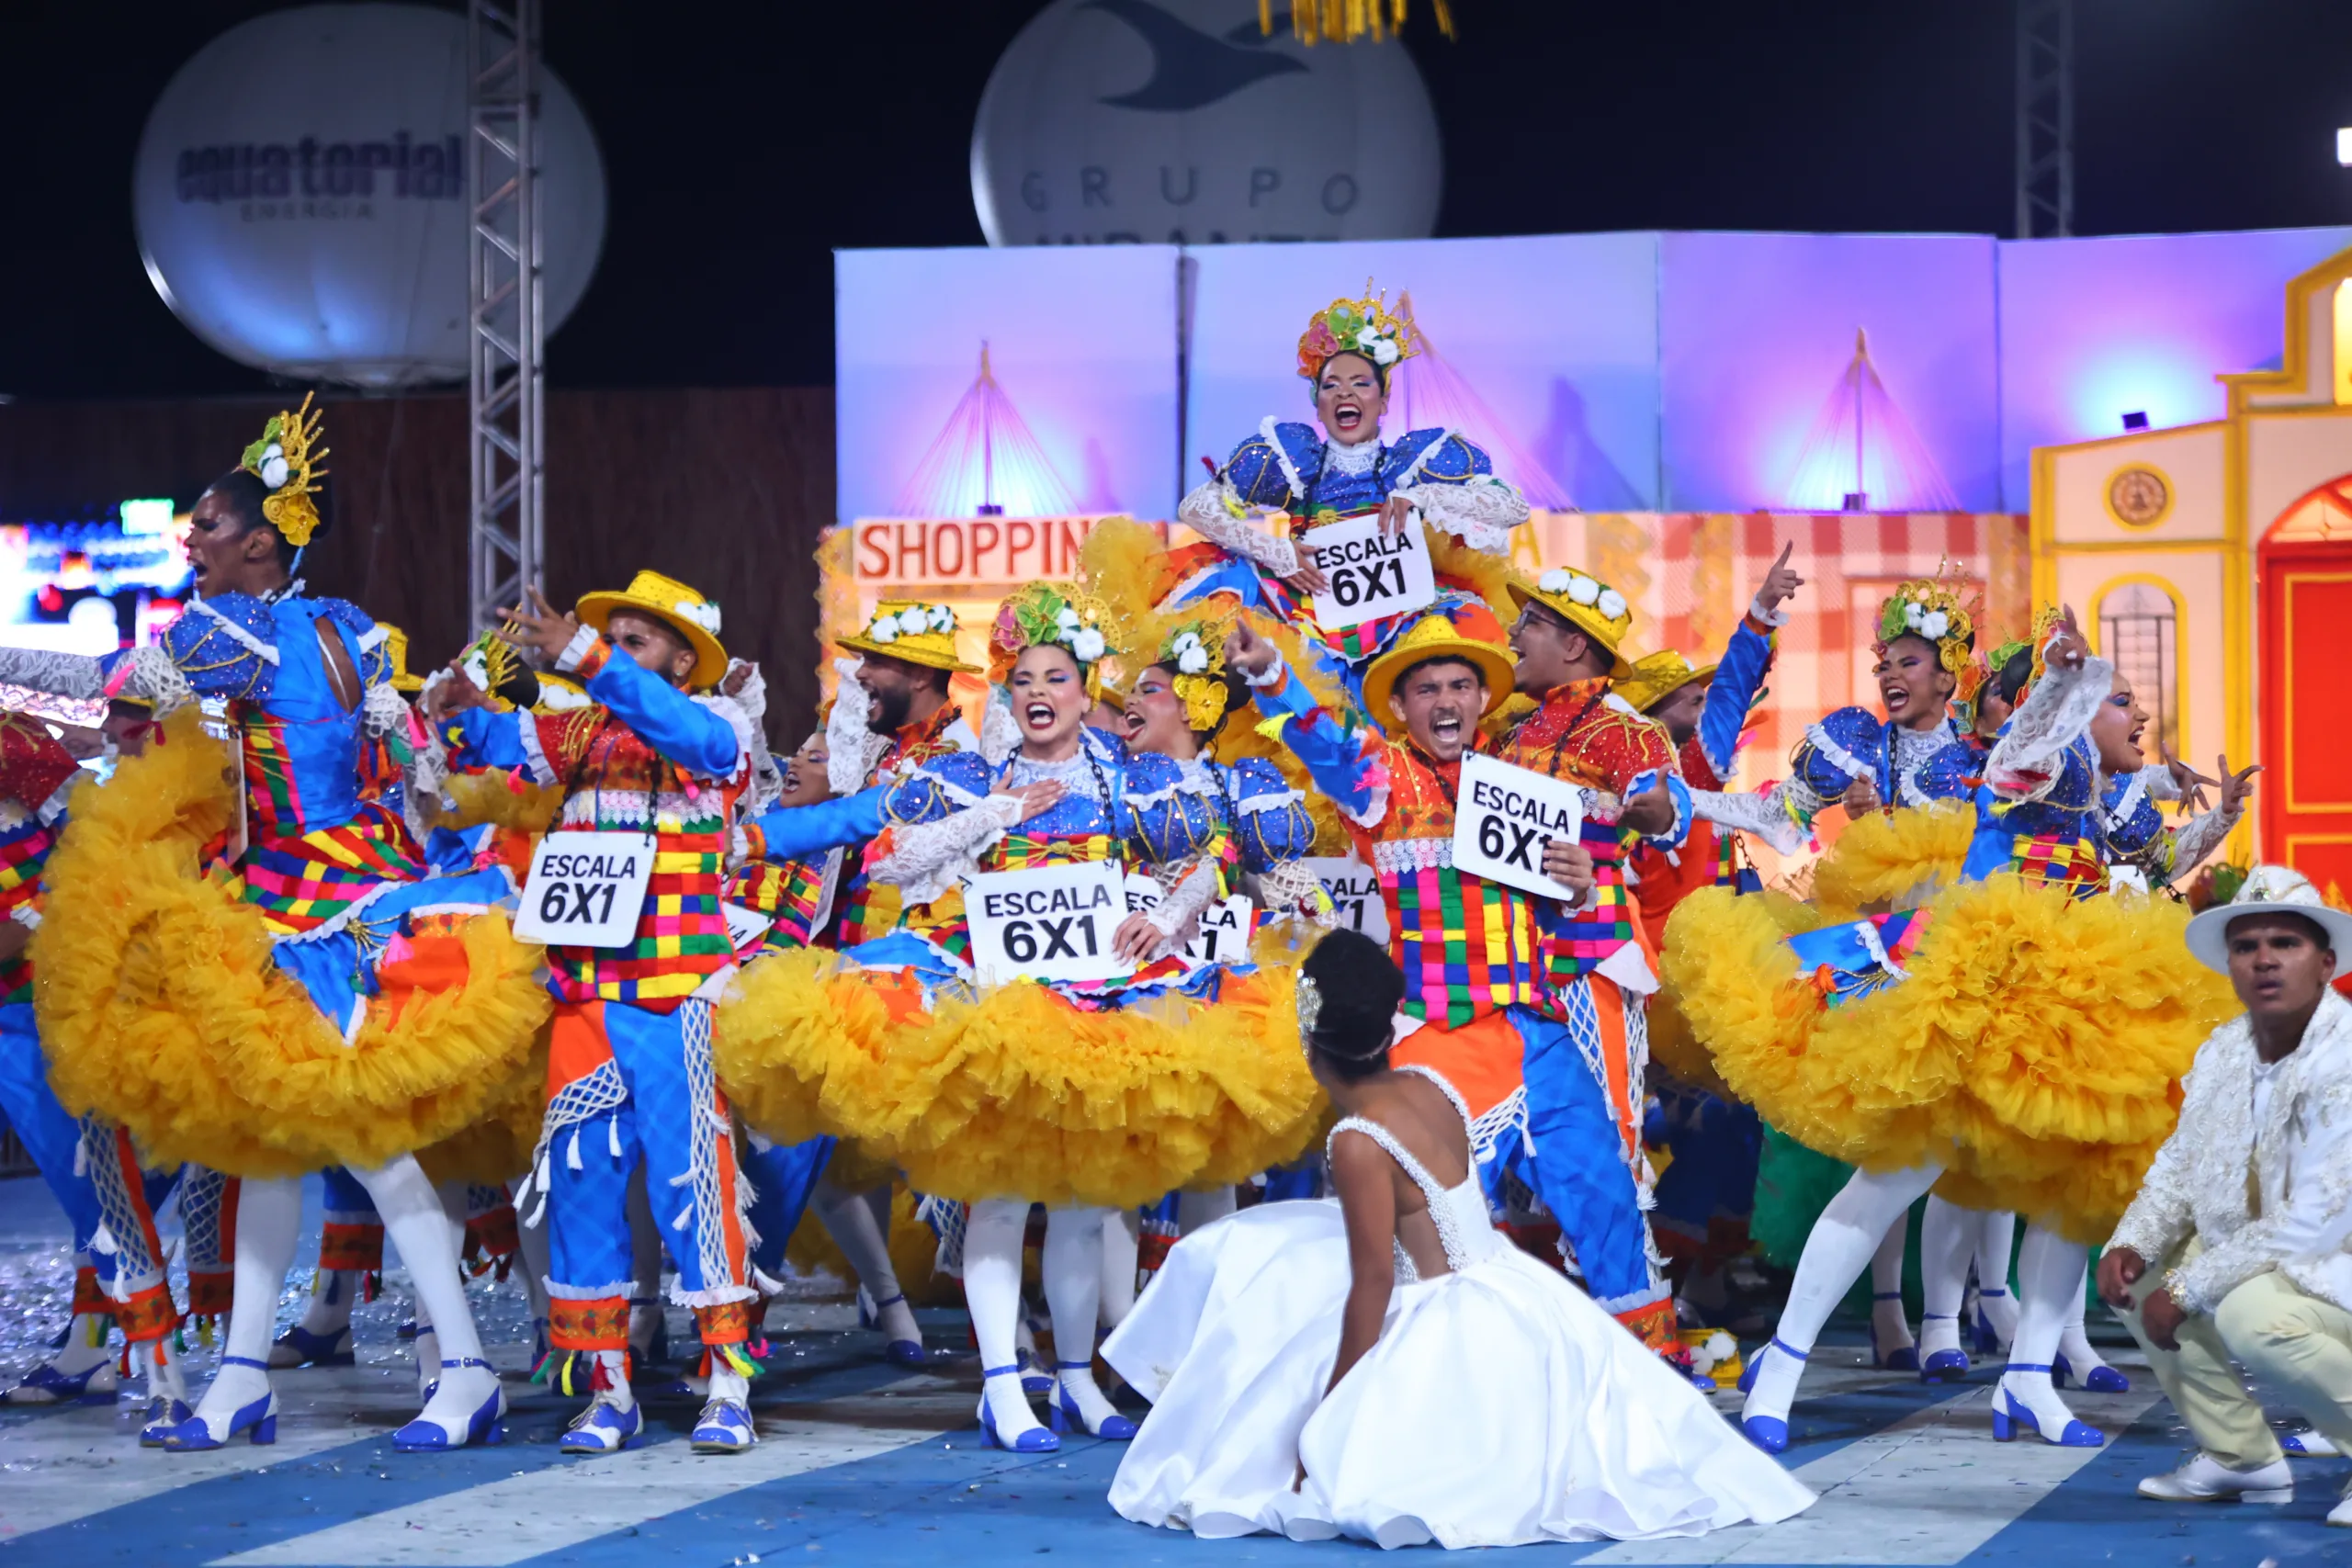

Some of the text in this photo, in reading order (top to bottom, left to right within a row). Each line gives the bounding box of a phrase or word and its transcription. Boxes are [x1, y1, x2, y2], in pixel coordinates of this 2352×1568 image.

[1021, 165, 1360, 216] GRUPO
[857, 520, 1092, 580] SHOPPIN
[1315, 532, 1413, 570] ESCALA
[1332, 558, 1406, 607] 6X1
[1473, 781, 1569, 835] ESCALA
[540, 854, 635, 879] ESCALA
[540, 882, 616, 924] 6X1
[984, 884, 1113, 919] ESCALA
[1002, 915, 1098, 963] 6X1
